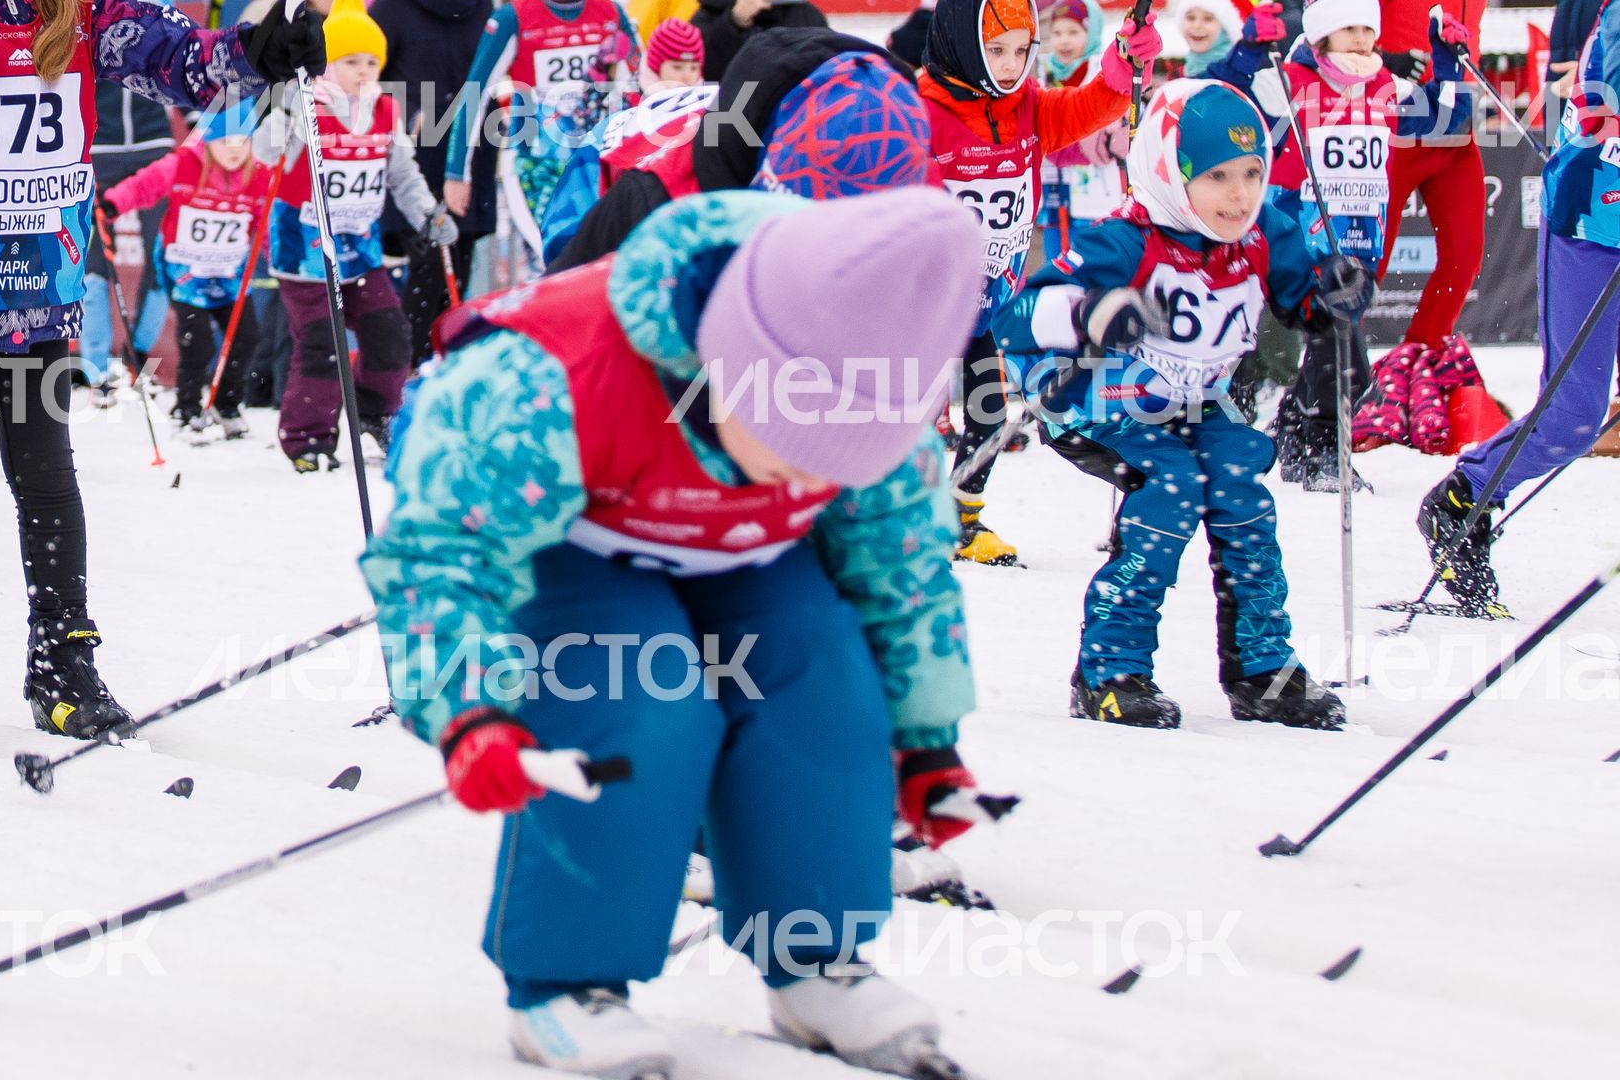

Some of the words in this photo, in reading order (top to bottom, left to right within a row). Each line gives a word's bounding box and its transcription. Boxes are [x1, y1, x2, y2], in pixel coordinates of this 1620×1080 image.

[1323, 136, 1383, 170] 630
[327, 168, 384, 199] 644
[191, 217, 242, 243] 672
